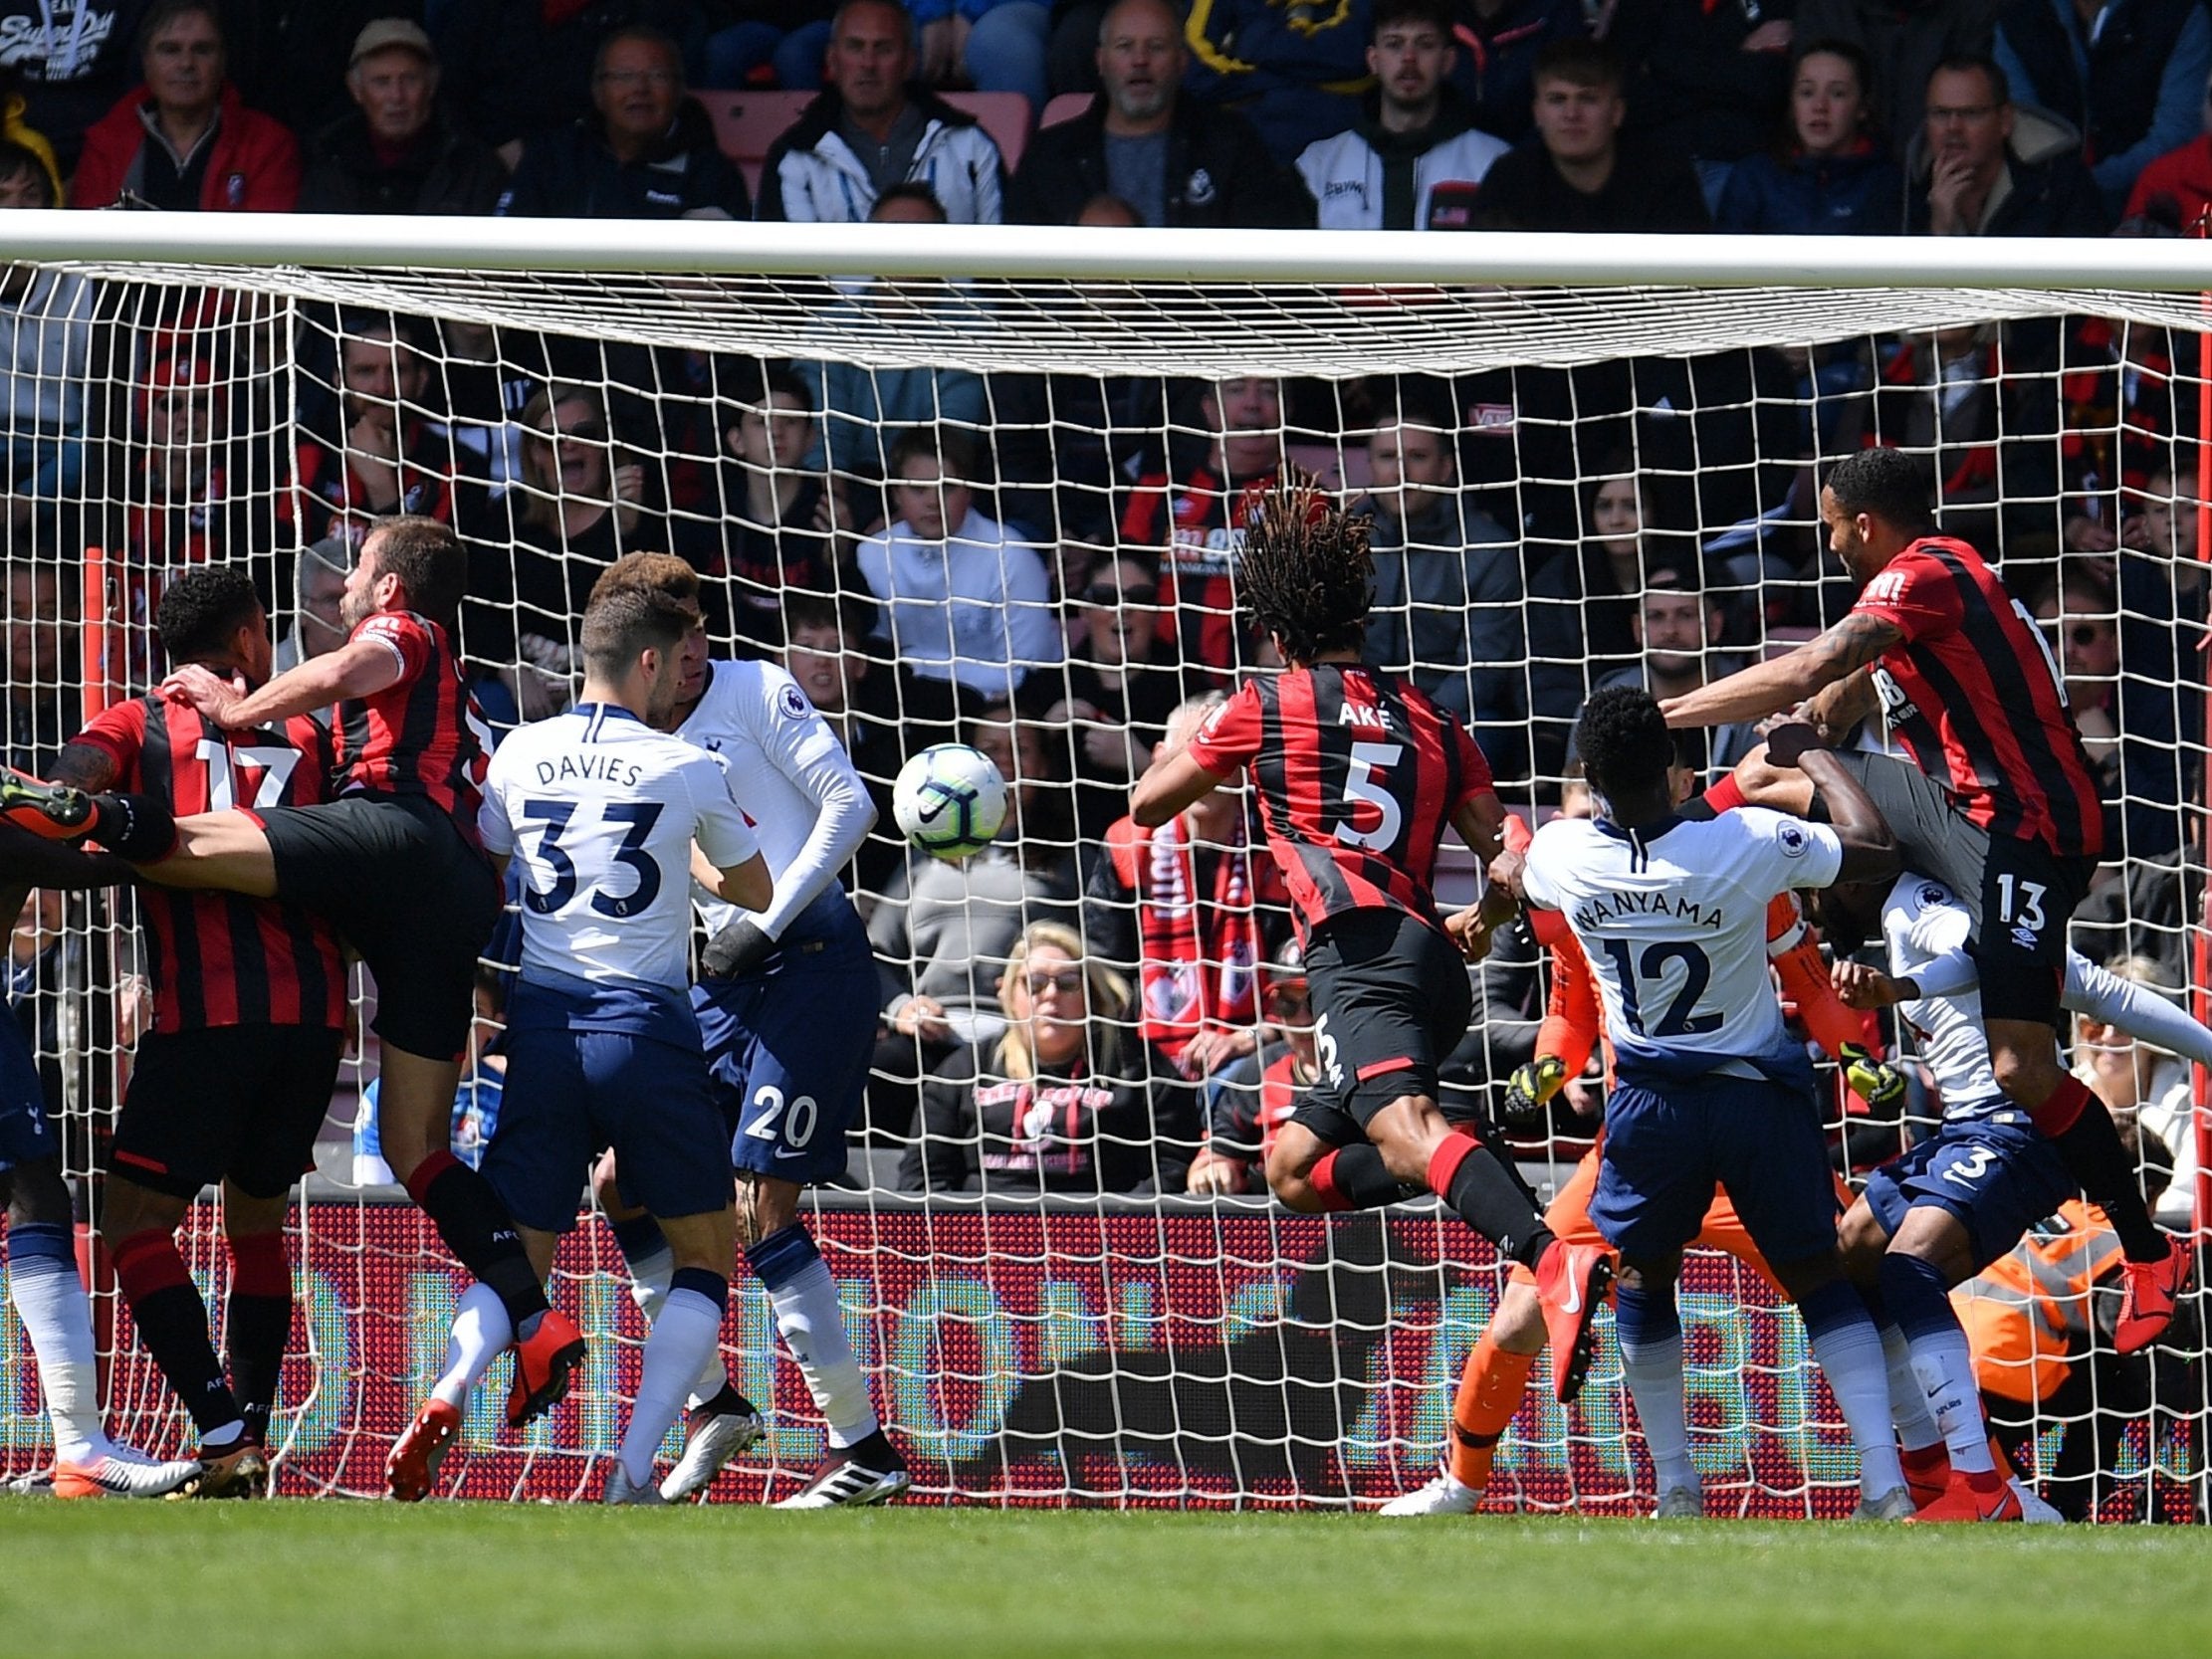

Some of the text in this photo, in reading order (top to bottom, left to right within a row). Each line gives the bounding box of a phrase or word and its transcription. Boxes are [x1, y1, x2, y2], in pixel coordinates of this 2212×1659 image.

[1338, 700, 1395, 730] AKÉ
[195, 737, 304, 813] 17
[536, 754, 643, 787] DAVIES
[1333, 741, 1404, 854] 5
[523, 799, 665, 919] 33
[1572, 891, 1723, 933] WANYAMA
[1996, 873, 2048, 932] 13
[1603, 938, 1725, 1038] 12
[744, 1085, 818, 1148] 20
[1950, 1145, 1998, 1178] 3
